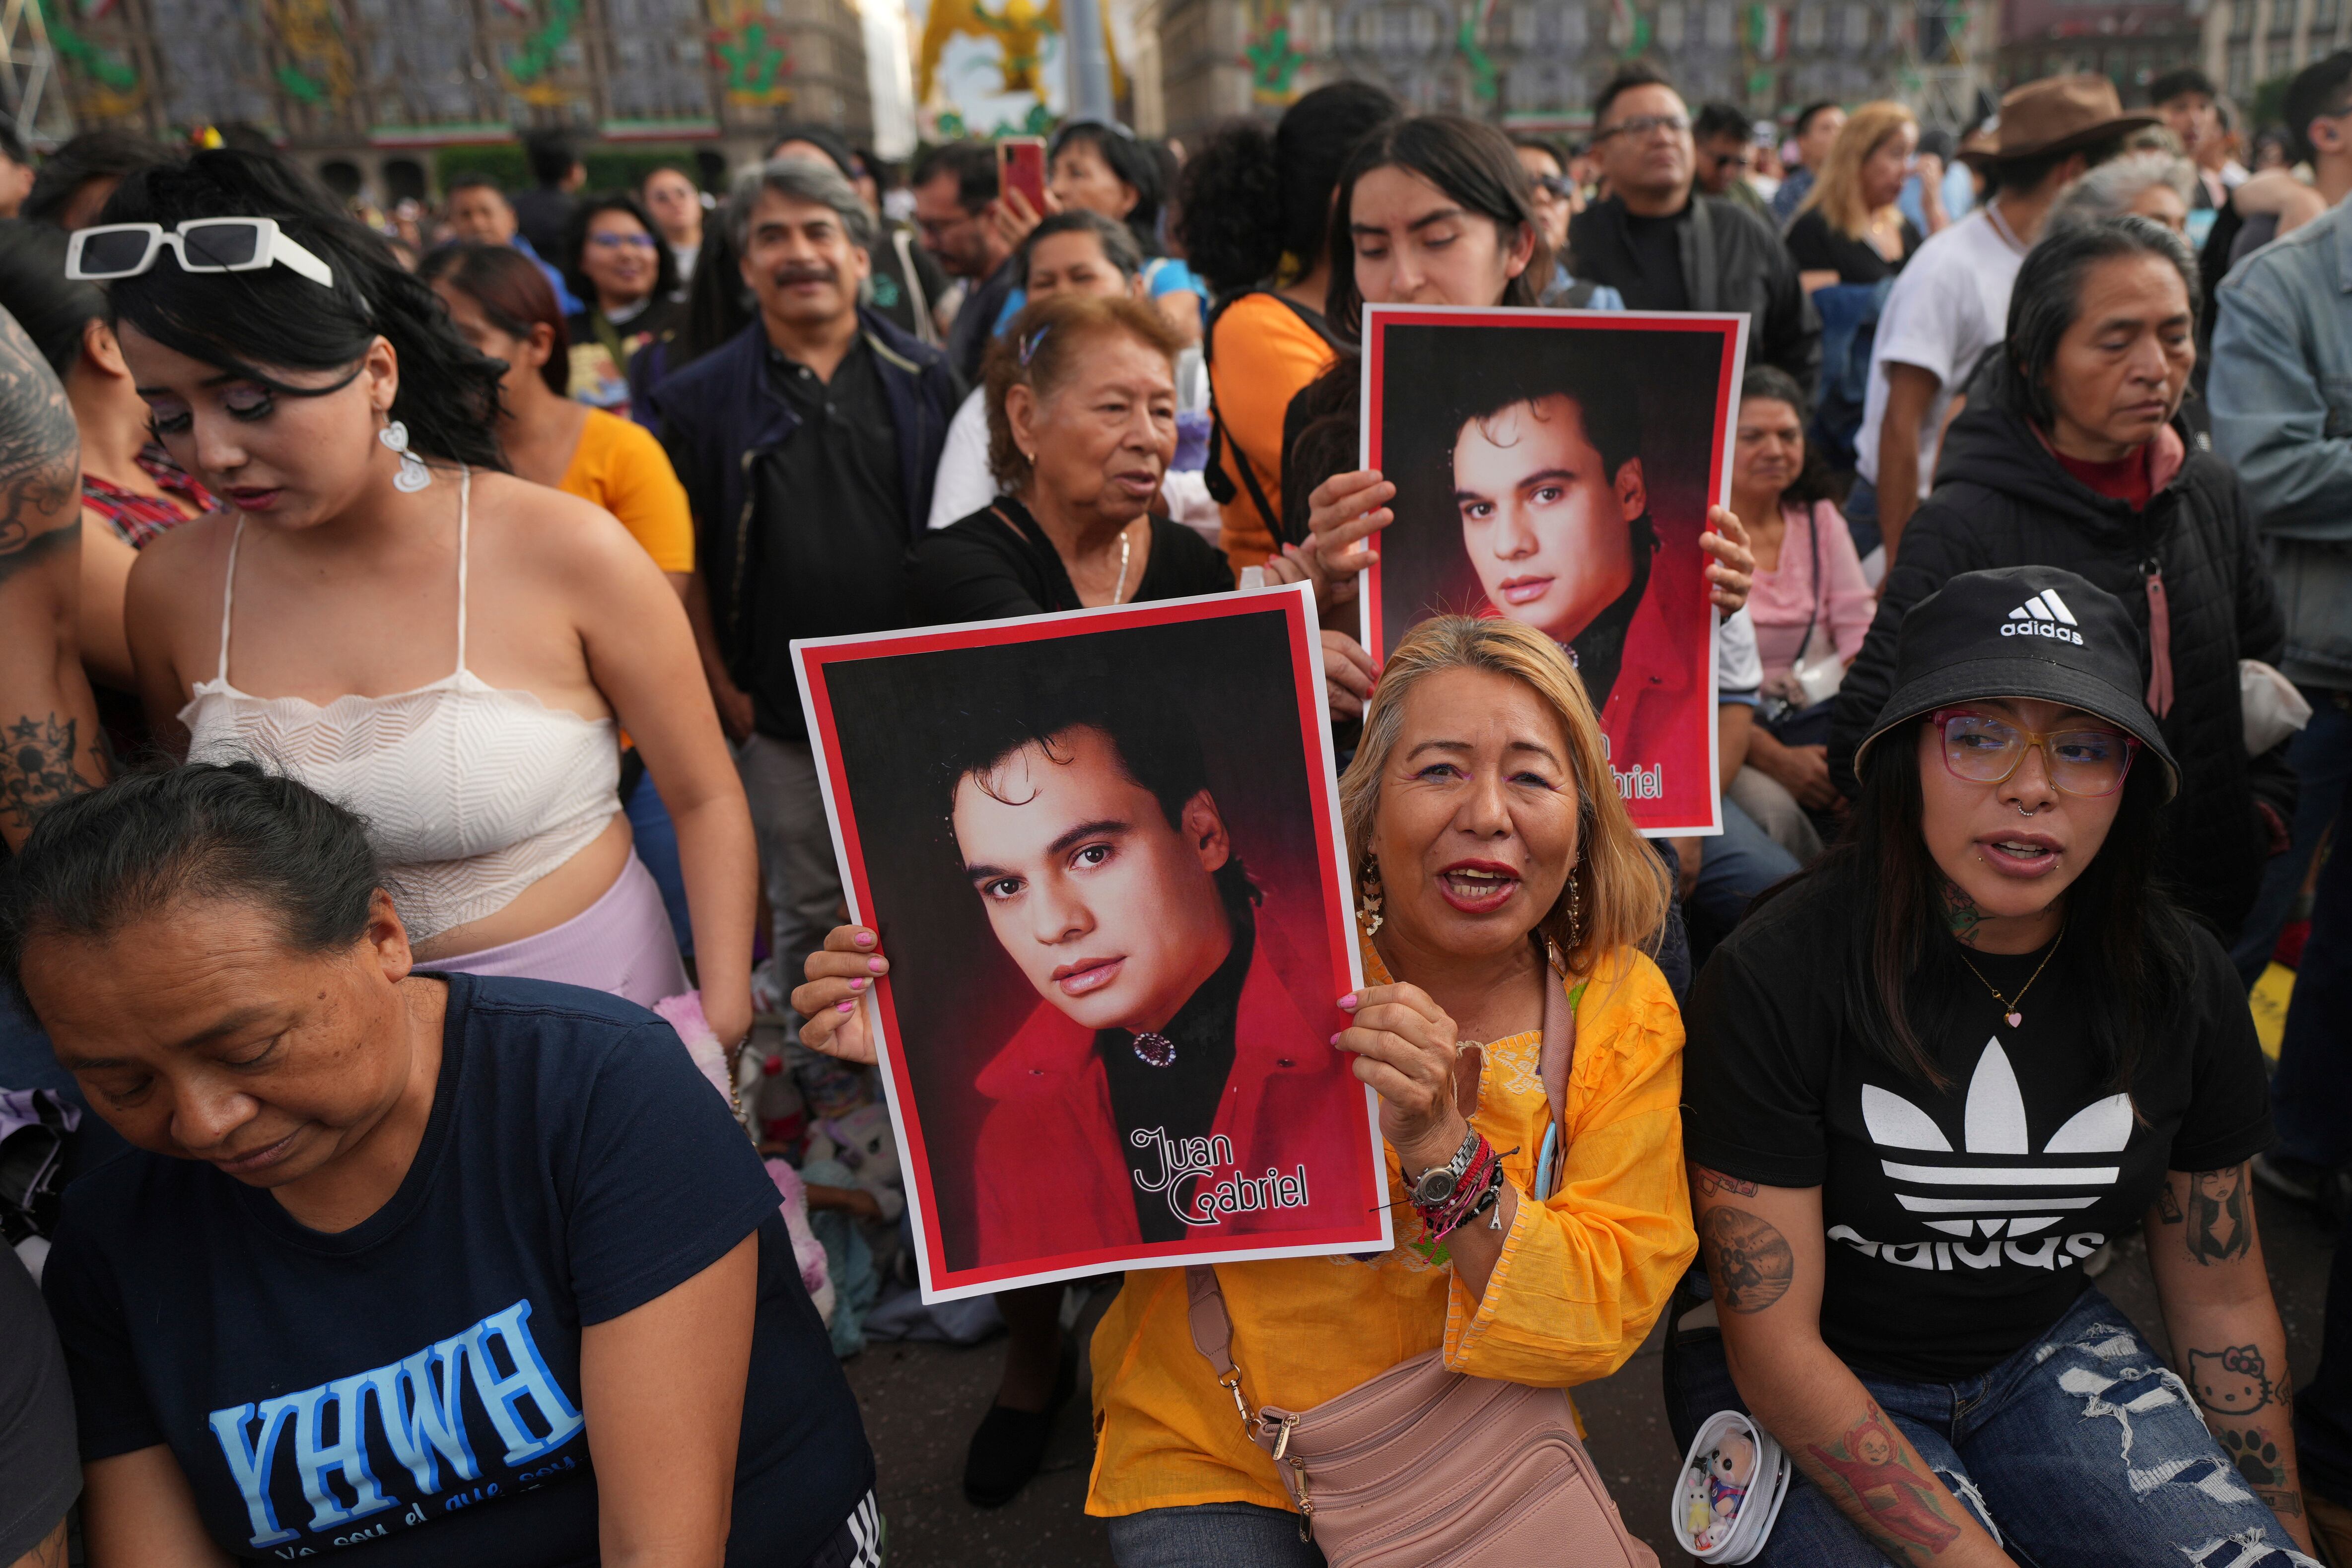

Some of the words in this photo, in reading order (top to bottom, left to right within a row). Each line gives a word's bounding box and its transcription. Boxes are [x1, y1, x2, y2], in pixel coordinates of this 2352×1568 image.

[2000, 620, 2084, 645] adidas
[1610, 762, 1662, 799] briel
[1131, 1125, 1234, 1192] Juan
[1168, 1163, 1309, 1226] Gabriel
[209, 1298, 586, 1549] YHWH
[405, 1502, 429, 1526] el
